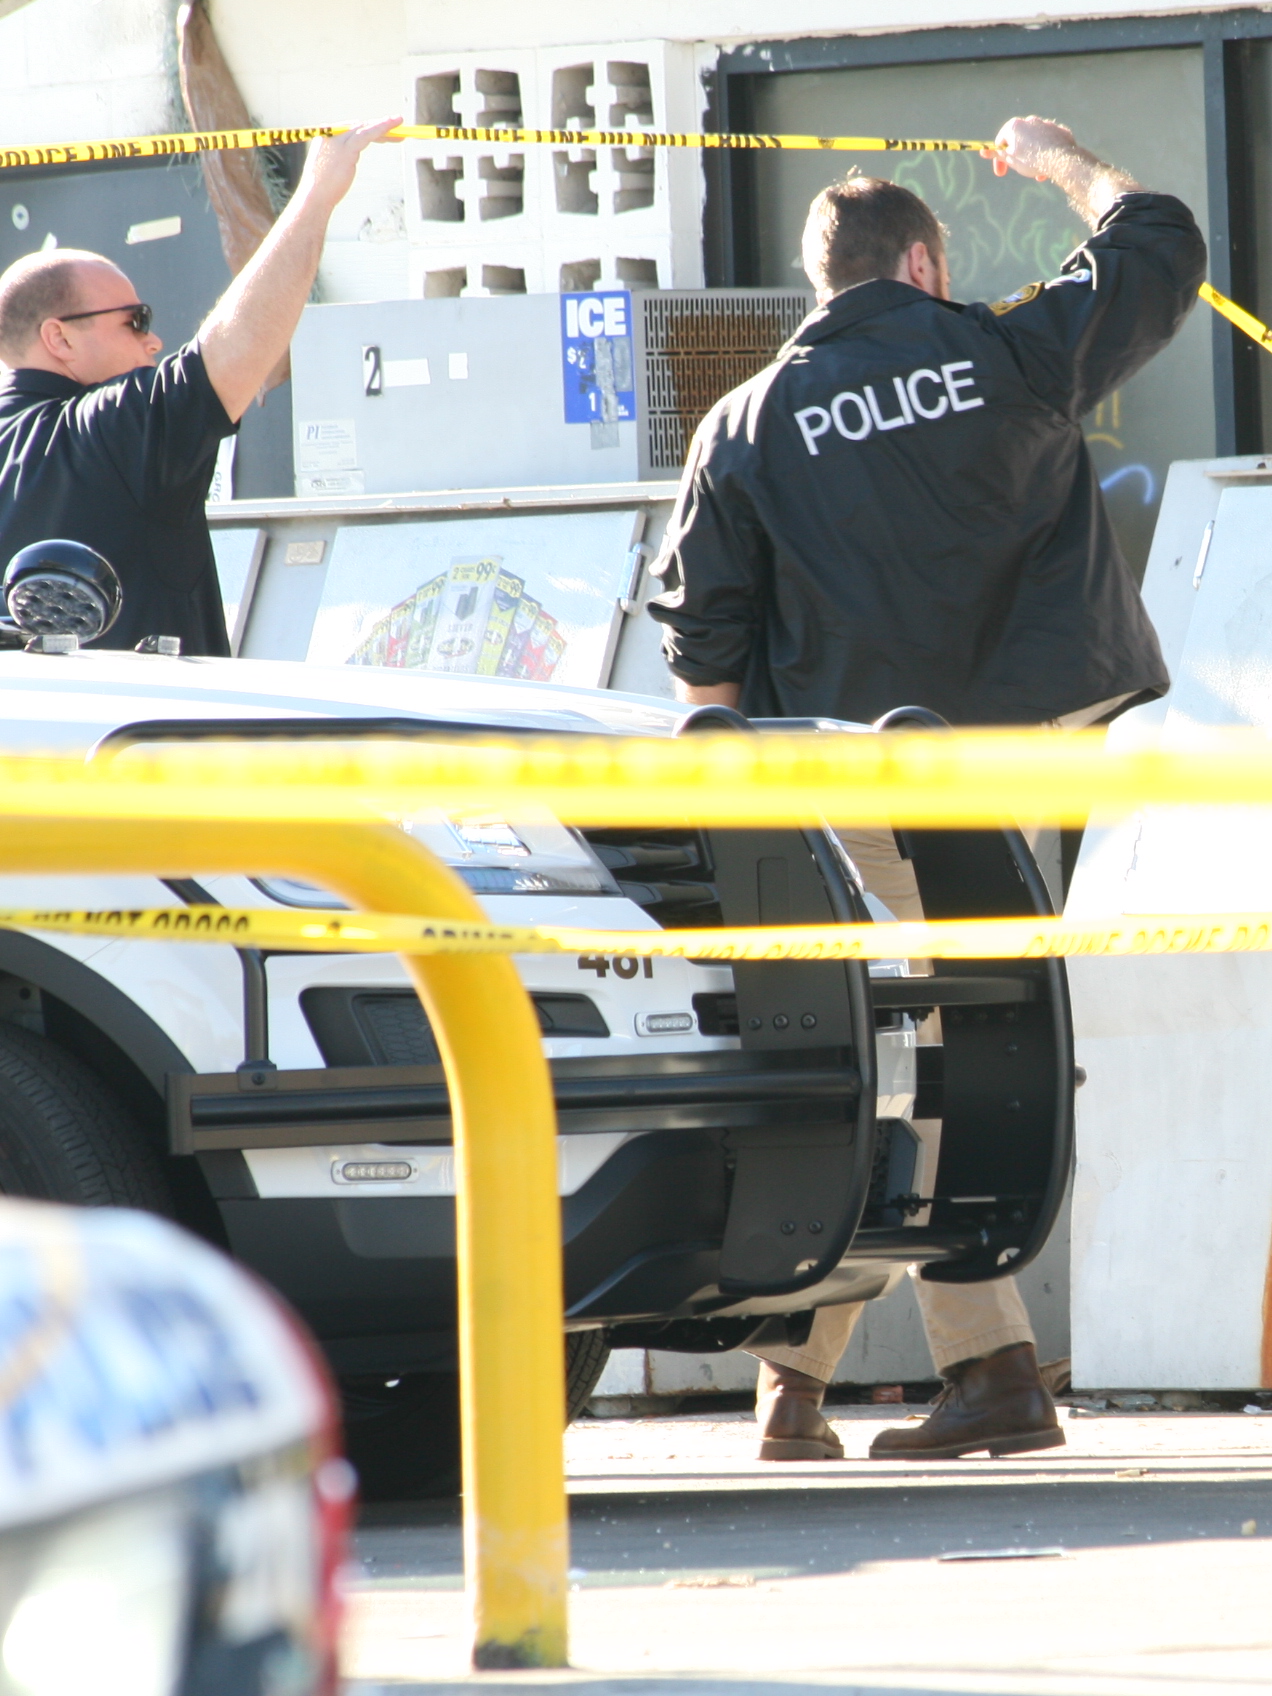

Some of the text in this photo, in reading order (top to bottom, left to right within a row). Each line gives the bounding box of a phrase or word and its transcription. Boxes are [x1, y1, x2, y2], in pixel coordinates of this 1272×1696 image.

[565, 297, 626, 338] ICE
[364, 346, 382, 397] 2
[794, 360, 984, 456] POLICE
